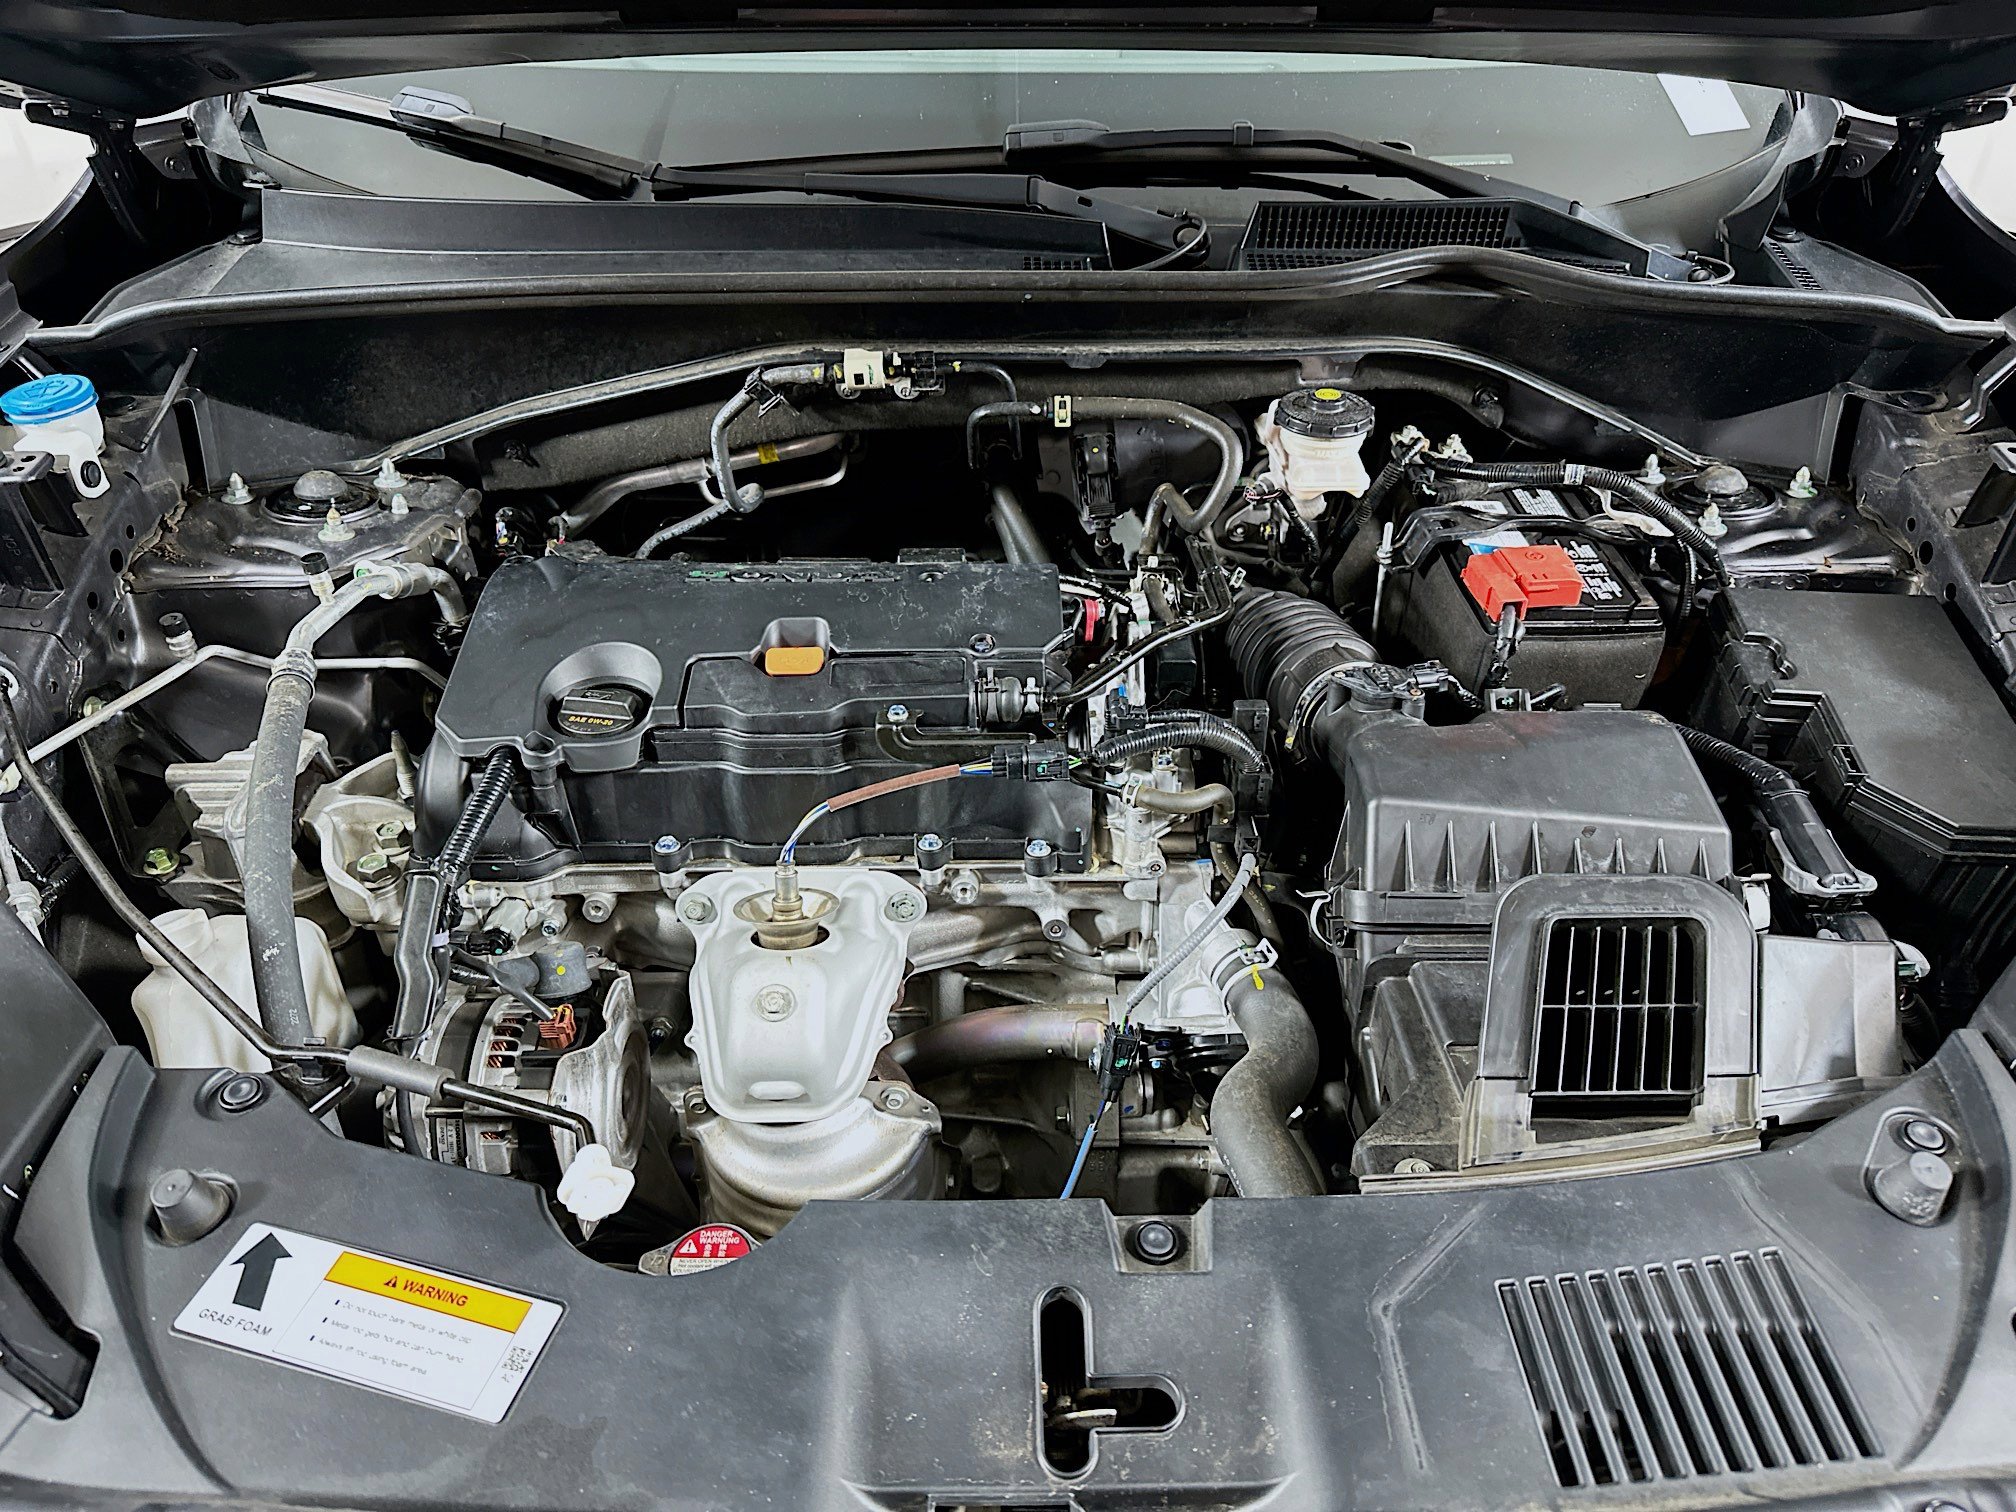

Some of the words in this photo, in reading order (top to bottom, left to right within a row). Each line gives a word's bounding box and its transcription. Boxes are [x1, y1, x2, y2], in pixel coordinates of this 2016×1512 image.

[588, 717, 613, 726] 0W-20
[403, 1279, 469, 1307] WARNING
[198, 1308, 235, 1326] GRAB
[234, 1318, 273, 1336] FOAM
